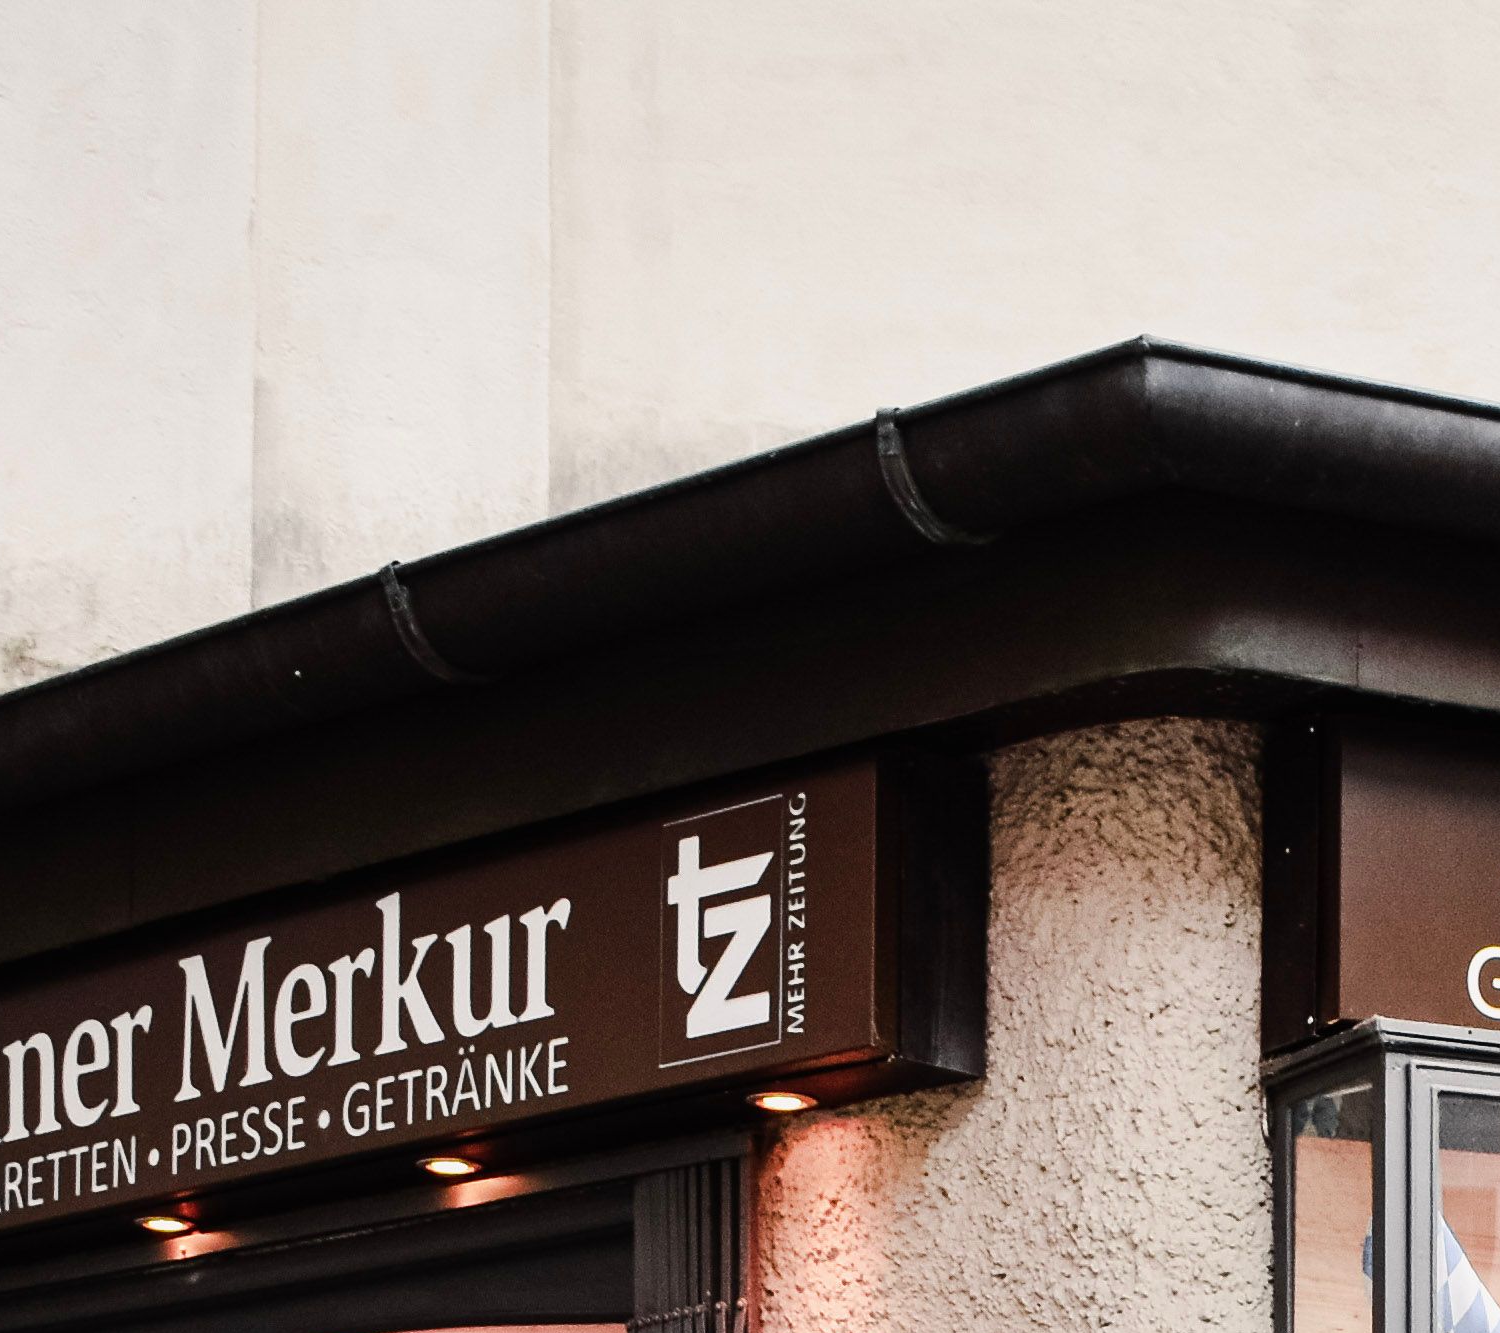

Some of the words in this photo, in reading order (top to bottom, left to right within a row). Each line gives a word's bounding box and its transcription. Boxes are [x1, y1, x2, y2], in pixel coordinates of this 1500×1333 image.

[788, 792, 807, 929] ZEITUNG
[175, 893, 572, 1099] Merkur
[667, 834, 774, 1040] tz
[786, 943, 807, 1035] MEHR
[170, 1107, 306, 1175] PRESSE
[343, 1038, 569, 1138] GETRÄNKE
